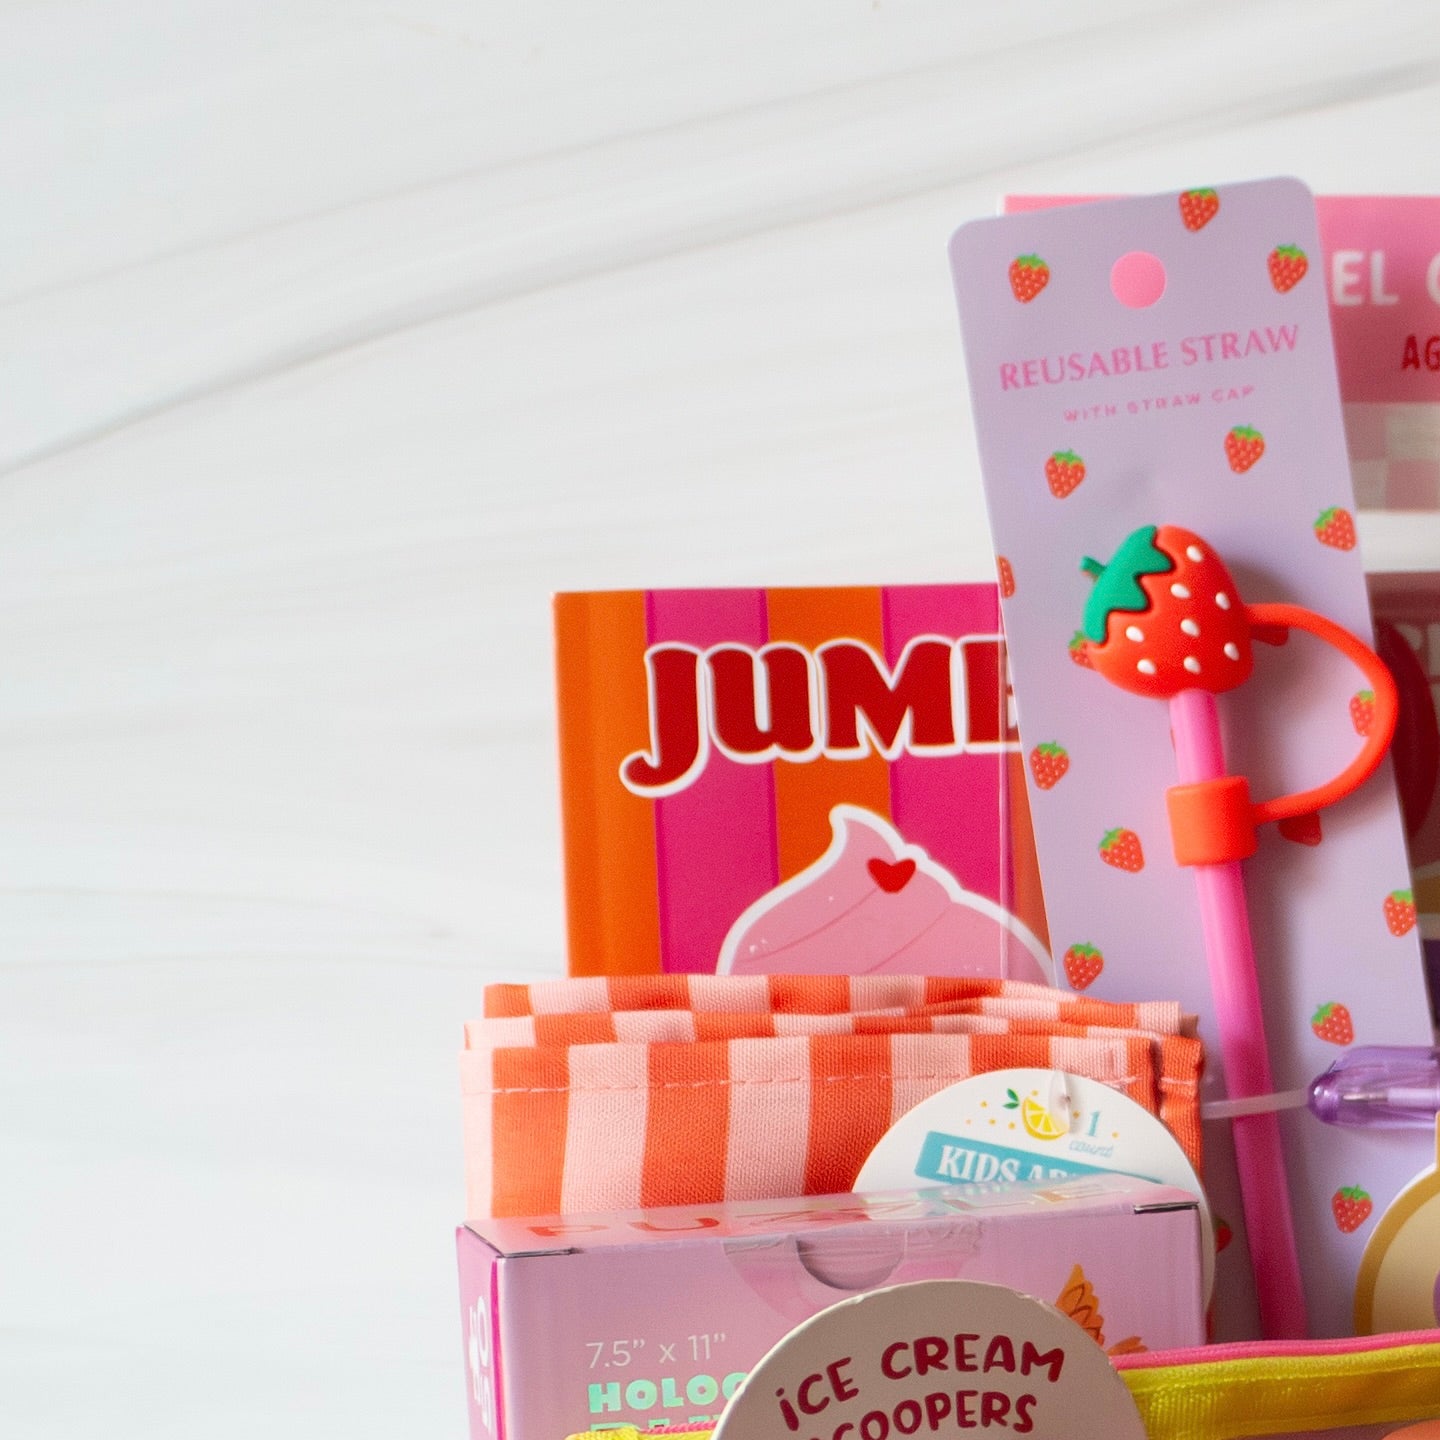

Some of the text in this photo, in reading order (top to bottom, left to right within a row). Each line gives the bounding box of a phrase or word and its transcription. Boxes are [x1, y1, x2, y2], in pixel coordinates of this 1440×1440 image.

[1000, 324, 1299, 391] REUSABLE STRAW
[1063, 384, 1255, 422] WITH STRAW CAP
[1085, 1110, 1102, 1139] 1
[936, 1144, 1021, 1183] KIDS
[881, 1333, 1065, 1383] CREAM
